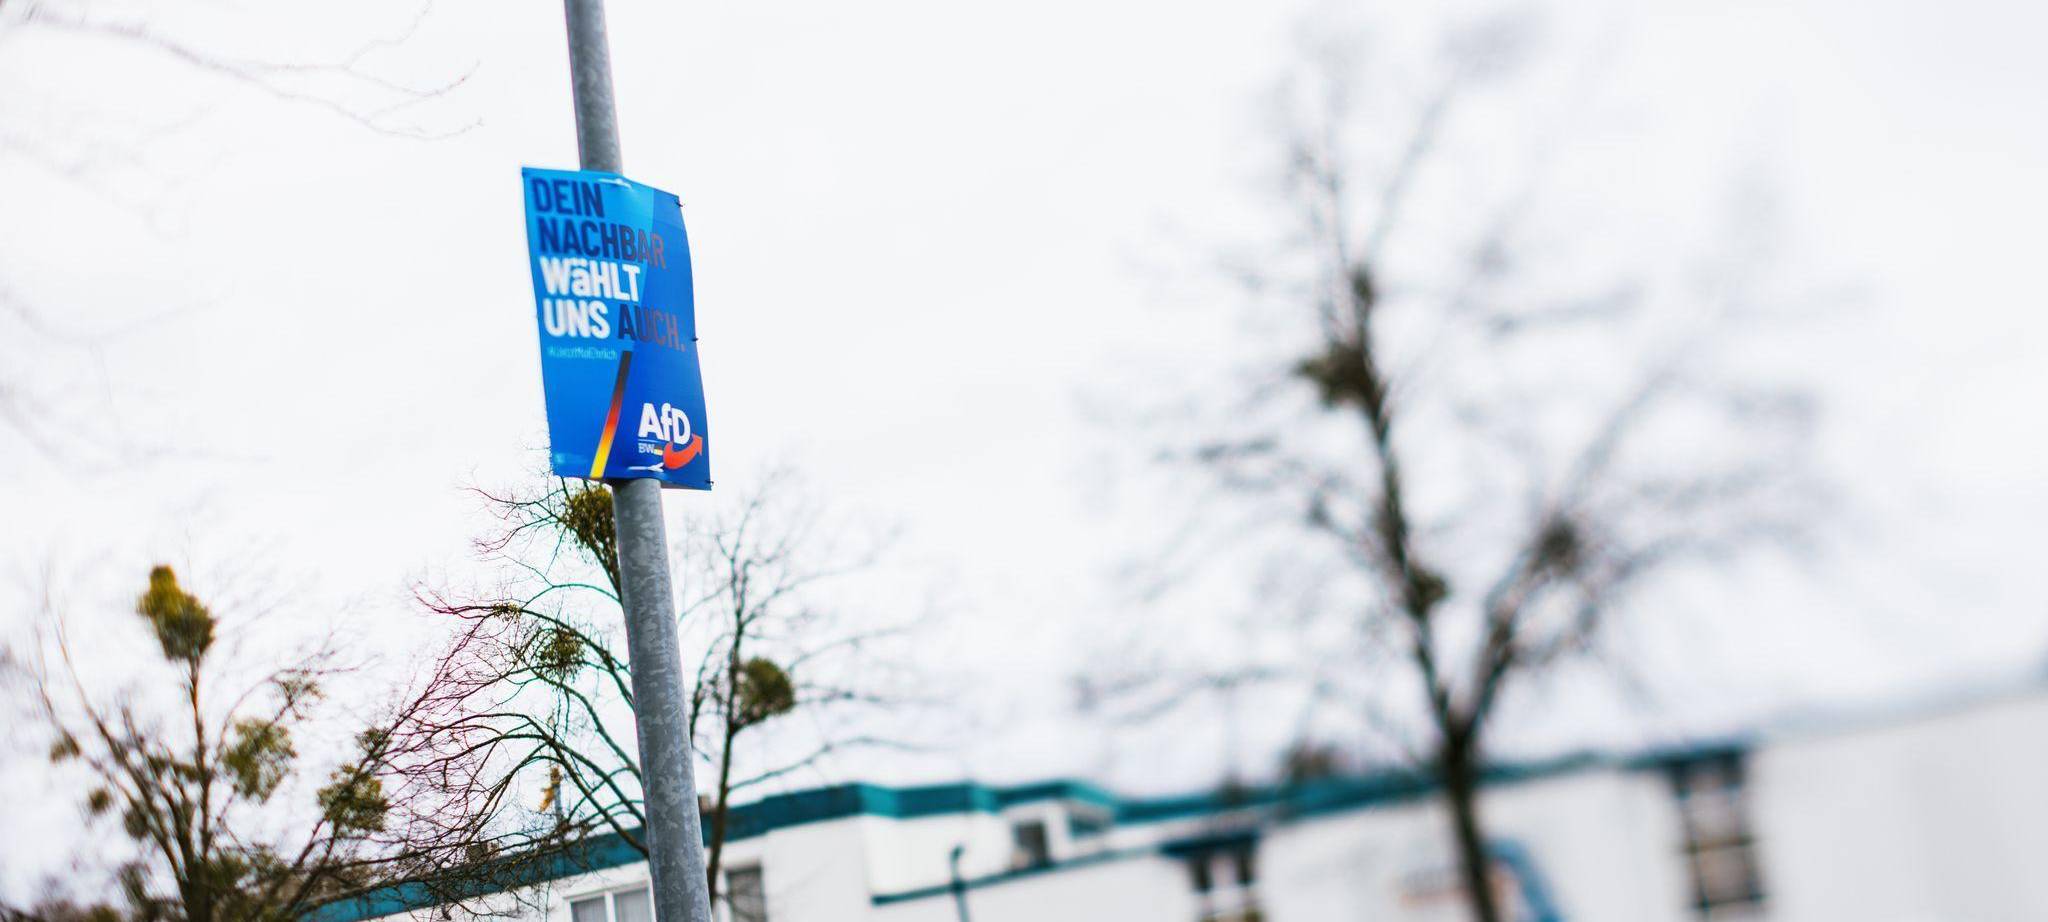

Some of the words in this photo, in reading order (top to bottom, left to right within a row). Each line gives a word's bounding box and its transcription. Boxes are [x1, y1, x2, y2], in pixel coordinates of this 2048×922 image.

[532, 178, 605, 217] DEIN
[538, 217, 666, 269] NACHBAR
[543, 299, 611, 339] UNS
[618, 303, 686, 352] AUCH.
[638, 403, 691, 444] AfD
